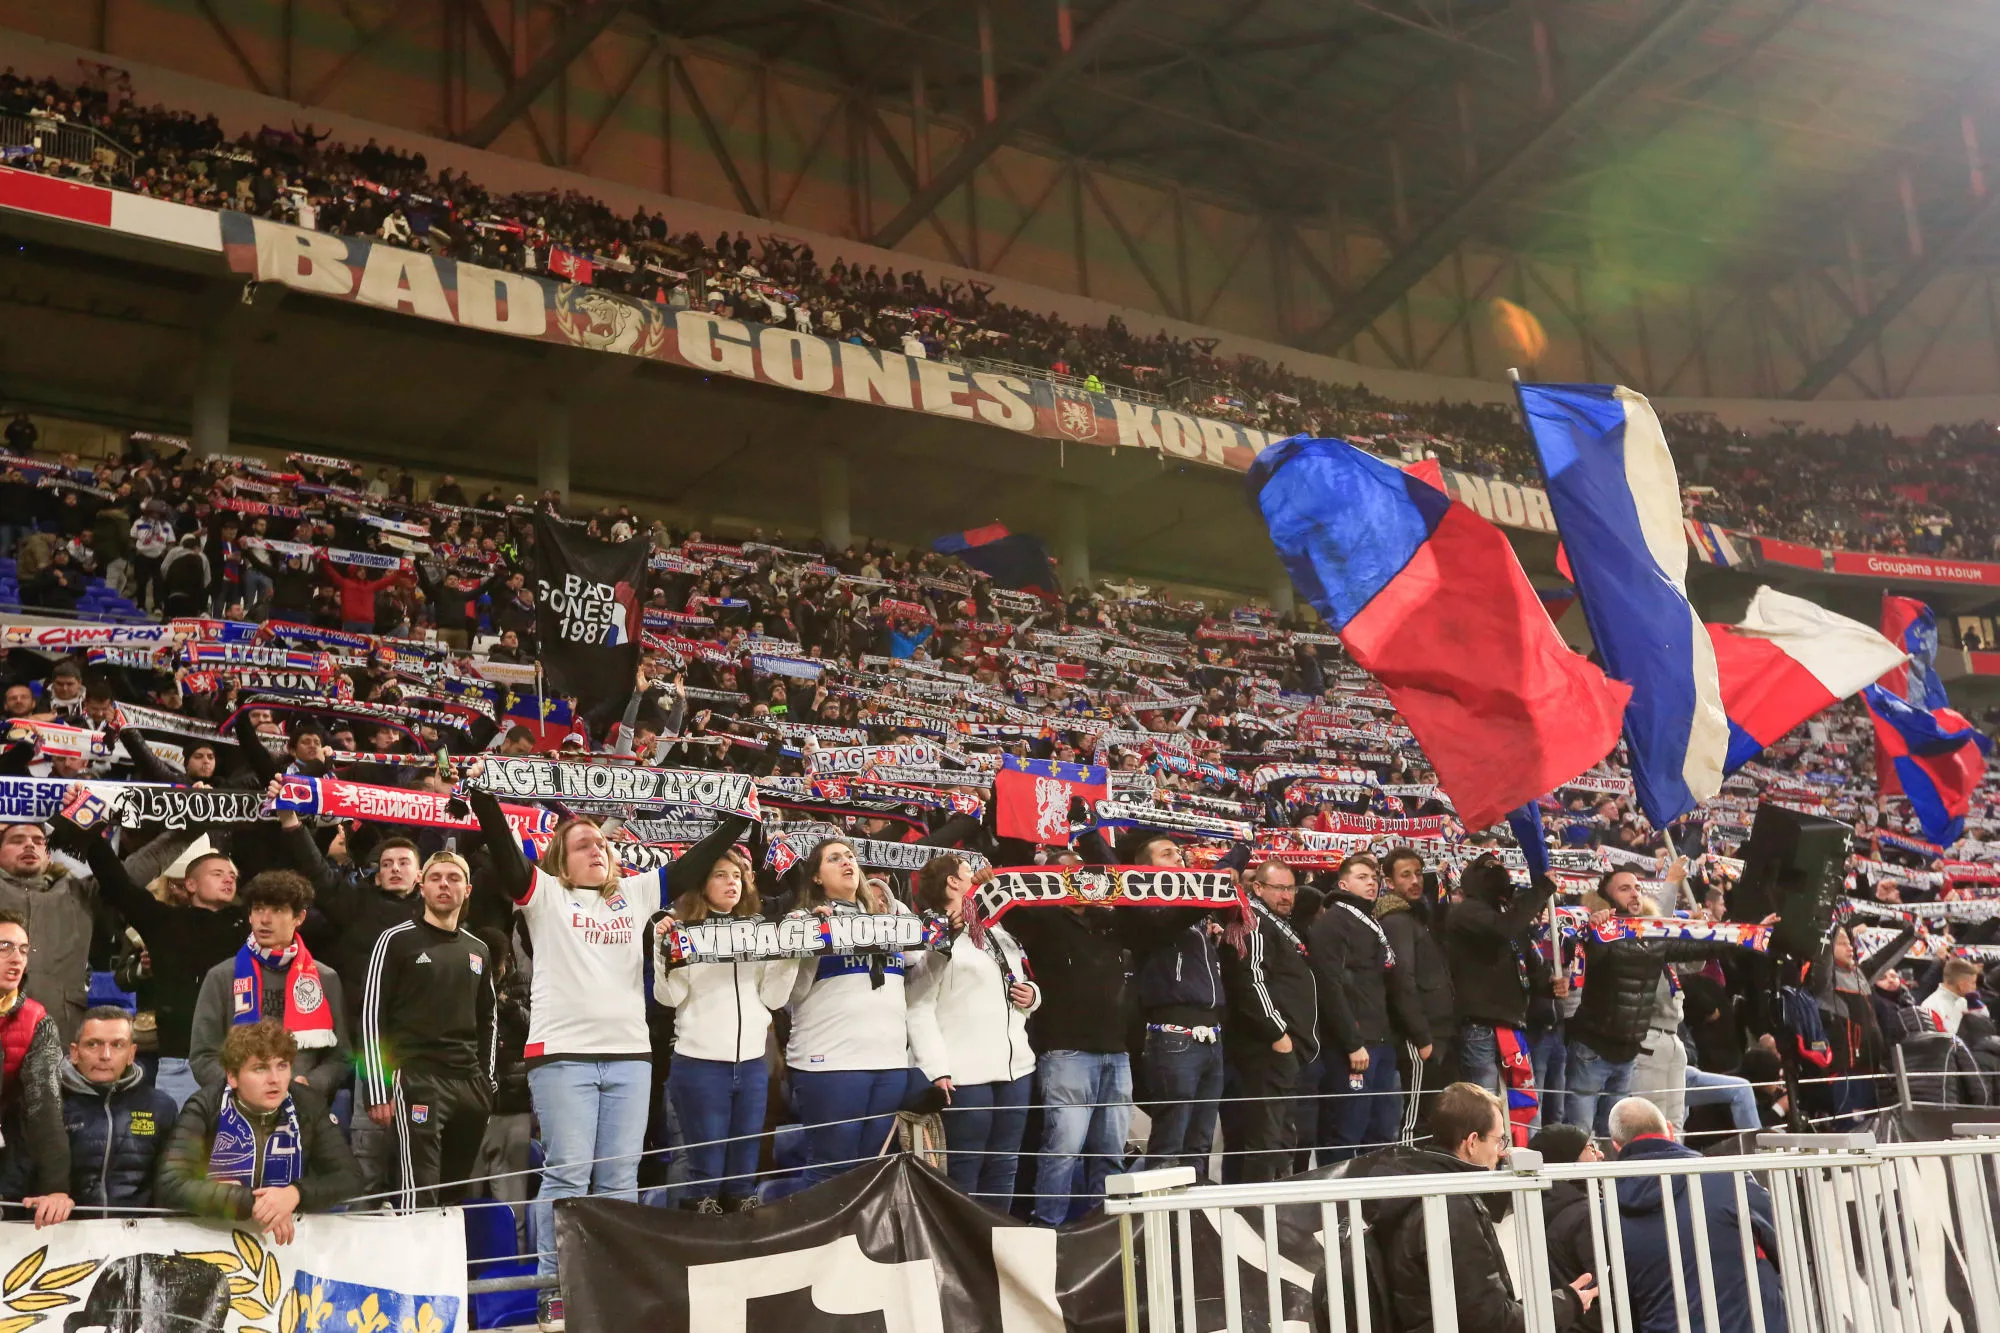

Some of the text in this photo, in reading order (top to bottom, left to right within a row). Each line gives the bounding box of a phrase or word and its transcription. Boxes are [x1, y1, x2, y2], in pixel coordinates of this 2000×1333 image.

[252, 217, 1036, 432] BAD GONES
[1115, 398, 1226, 465] KOP
[1868, 557, 1982, 580] Groupama STADIUM
[538, 579, 615, 623] GONES
[564, 573, 615, 602] BAD
[274, 624, 366, 646] OLYMPIQUE LYONNAIS
[559, 618, 612, 645] 1987
[224, 643, 288, 668] LYON
[241, 672, 318, 691] LYON
[558, 762, 658, 800] NORD
[663, 770, 750, 811] LYON
[1338, 811, 1377, 832] Virage
[1411, 817, 1439, 833] Lyon
[1307, 833, 1356, 852] VIRAGE
[979, 869, 1238, 921] BAD GONE
[687, 914, 923, 957] VIRAGE NORD
